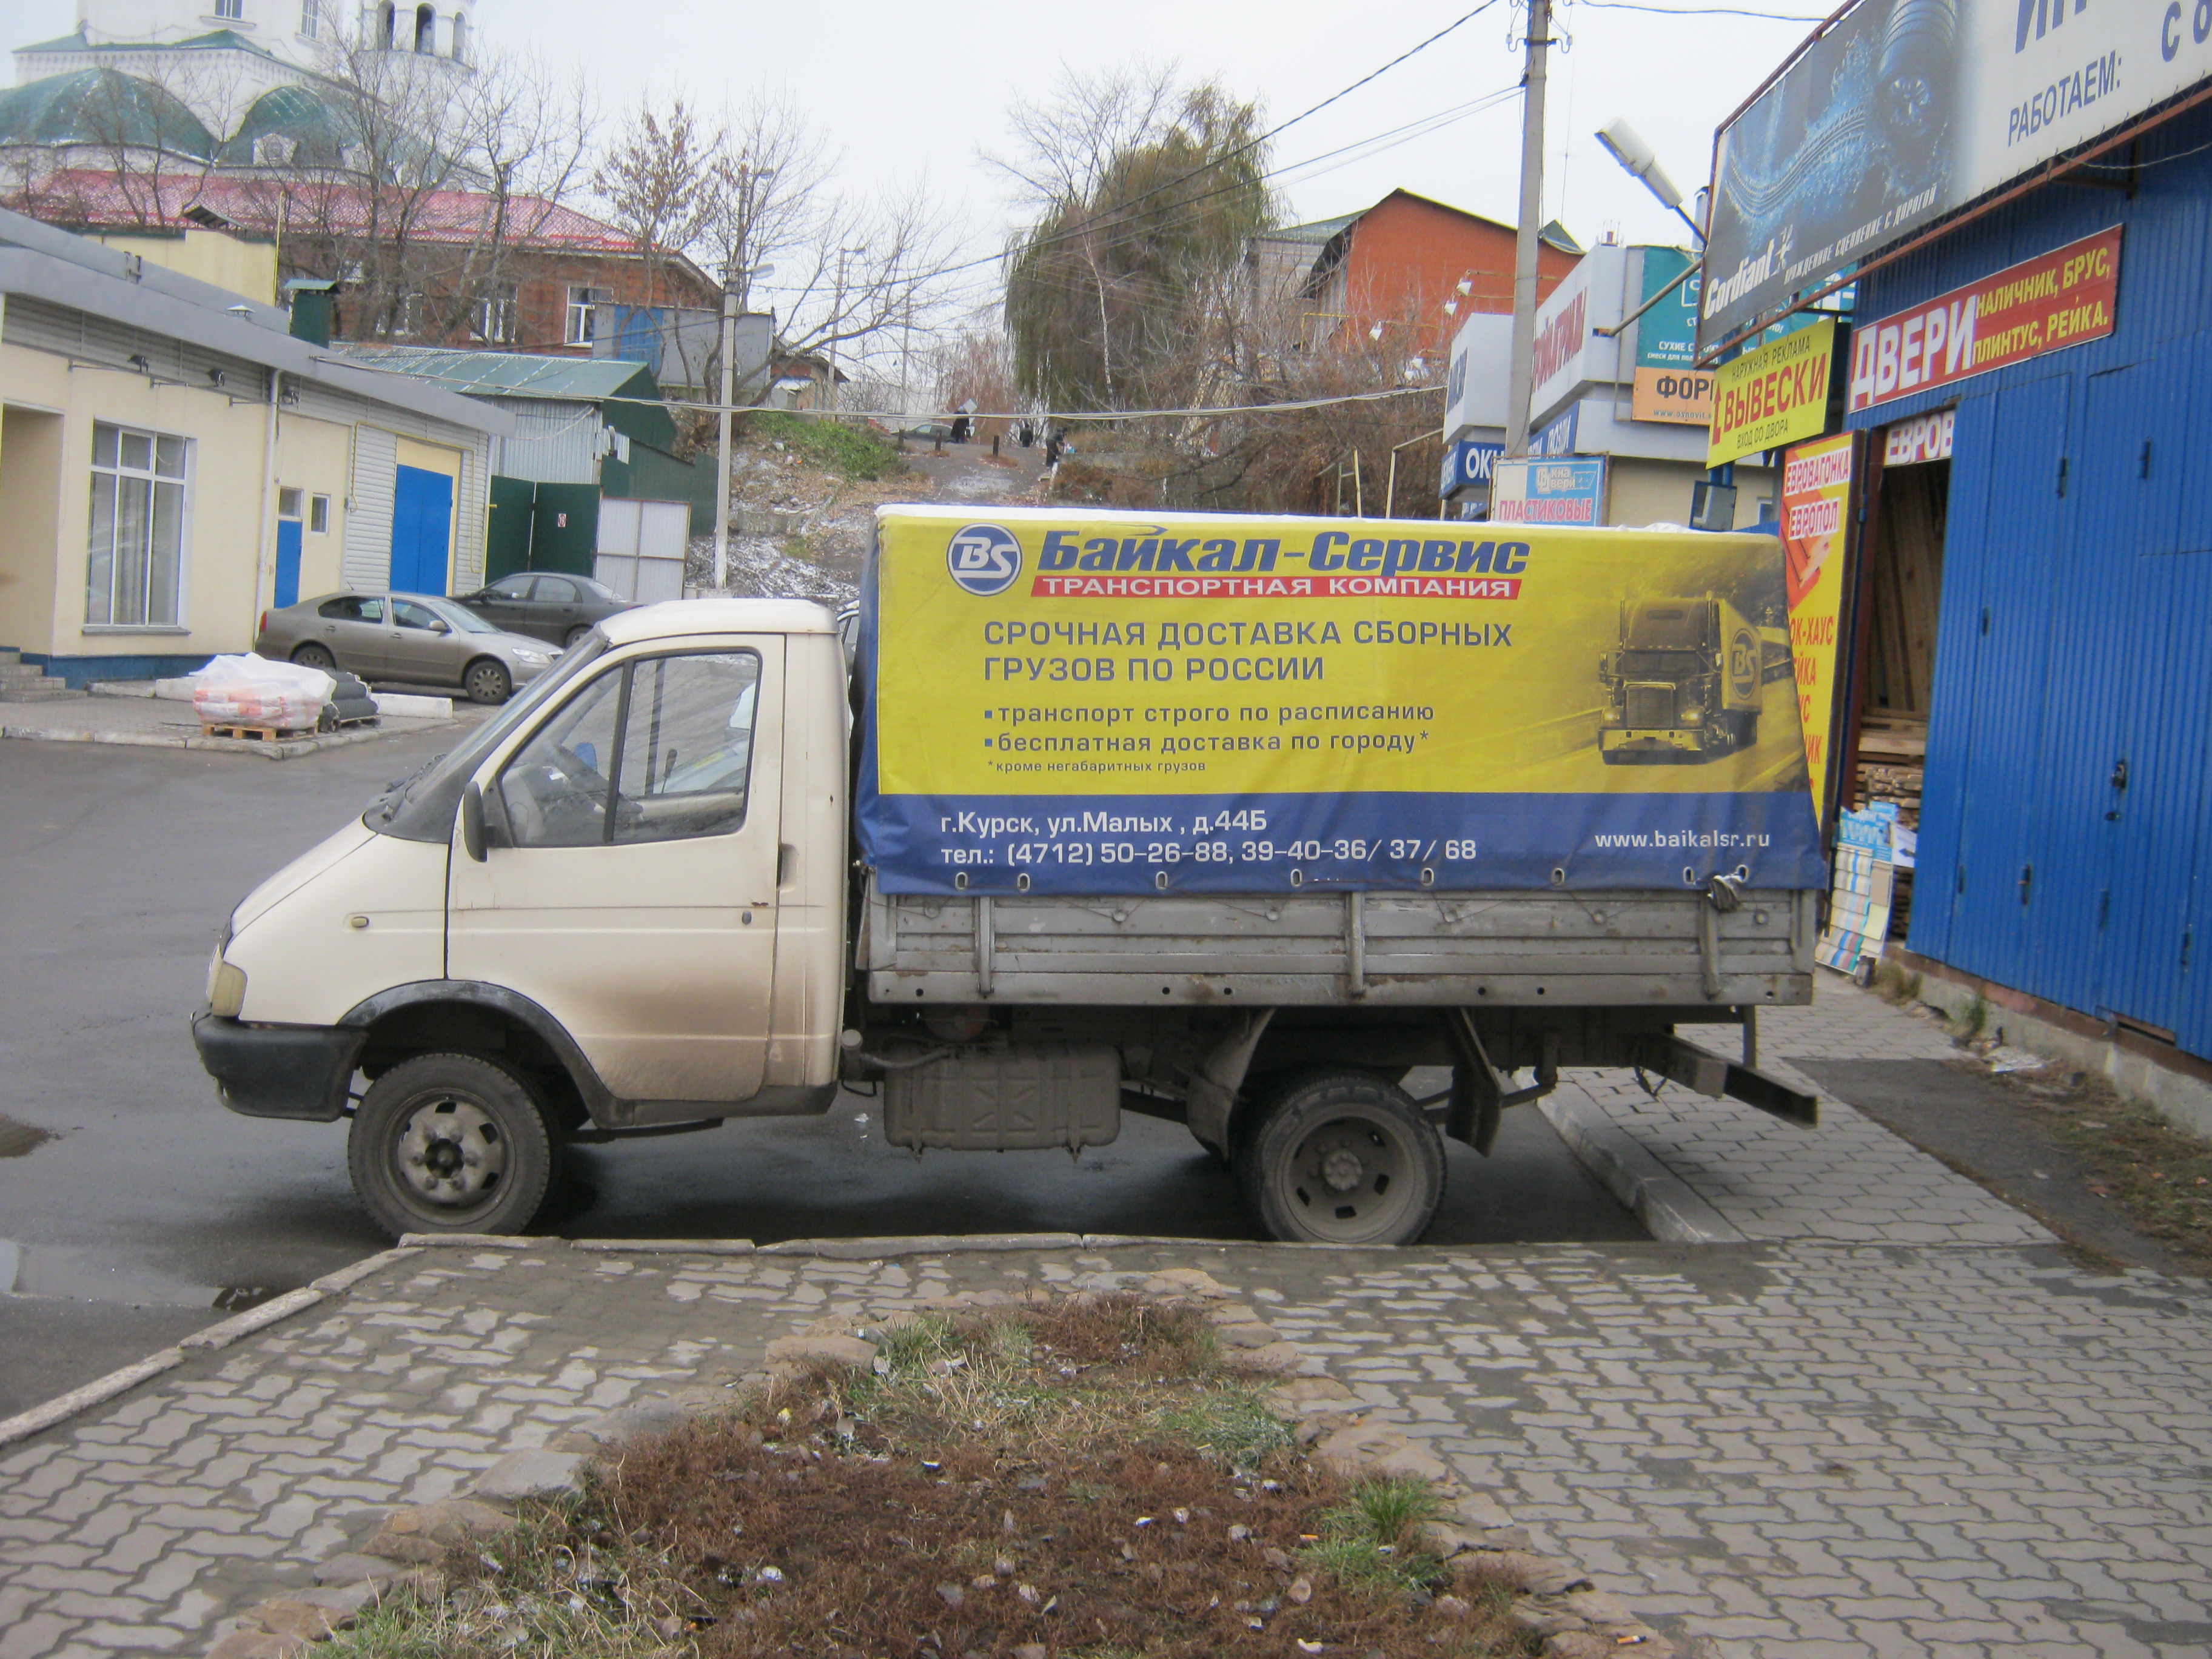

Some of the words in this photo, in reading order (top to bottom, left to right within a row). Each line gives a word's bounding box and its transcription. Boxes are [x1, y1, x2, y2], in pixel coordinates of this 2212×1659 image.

[2008, 50, 2122, 147] РАБОТАЕМ:
[1835, 215, 1883, 256] СЦЕПЛЕНИЕ
[1893, 183, 1937, 227] ДОРОГОЙ
[1703, 238, 1775, 320] Cordiant
[1976, 268, 2059, 320] НАЛИЧНИК,
[2062, 247, 2111, 289] БРУС,
[1658, 341, 1686, 351] СУХИЕ
[1972, 321, 2043, 366] ПЛИНТУС,
[2046, 295, 2108, 342] РЕЙКА.
[1732, 352, 1769, 383] НАРУЖНАЯ
[1772, 335, 1810, 366] РЕКЛАМА
[1849, 295, 1979, 412] ДВЕРИ
[1656, 376, 1714, 401] ФОР
[1723, 352, 1826, 433] ВЫВЕСКИ
[1737, 429, 1752, 449] ВХОД
[1754, 427, 1763, 443] СО
[1765, 418, 1788, 442] ДВОРА
[1785, 448, 1851, 495] ЕВРОВАГОНКА
[1499, 498, 1592, 522] ПЛАСТИКОВЫЕ
[1789, 498, 1840, 540] ЕВРОПОЛ
[1037, 524, 1530, 577] Байкал-Сервис
[1042, 578, 1312, 596] ТРАНСПОРТНАЯ
[1329, 578, 1510, 597] КОМПАНИЯ
[984, 621, 1145, 646] СРОЧНАЯ
[1158, 621, 1342, 651] ДОСТАВКА
[1353, 620, 1512, 647] СБОРНЫХ
[1789, 616, 1834, 645] ОК-ХАУС
[984, 657, 1116, 682] ГРУЗОВ
[1128, 658, 1173, 682] ПО
[1186, 657, 1324, 681] РОССИИ
[998, 707, 1134, 727] транспорт
[1144, 707, 1230, 727] строго
[1239, 706, 1269, 721] по
[1278, 705, 1434, 726] расписанию
[998, 732, 1151, 752] бесплатная
[1161, 736, 1281, 754] доставка
[1291, 734, 1320, 750] по
[1047, 760, 1153, 774] негабаритных
[1158, 761, 1207, 774] грузов
[940, 811, 1040, 839] г.Курск,
[1191, 809, 1267, 836] д.44Б
[1594, 830, 1770, 848] www.baikalsr.ru
[940, 848, 994, 864] тел.:
[1008, 843, 1093, 866] (4712)
[1444, 839, 1477, 860] 68
